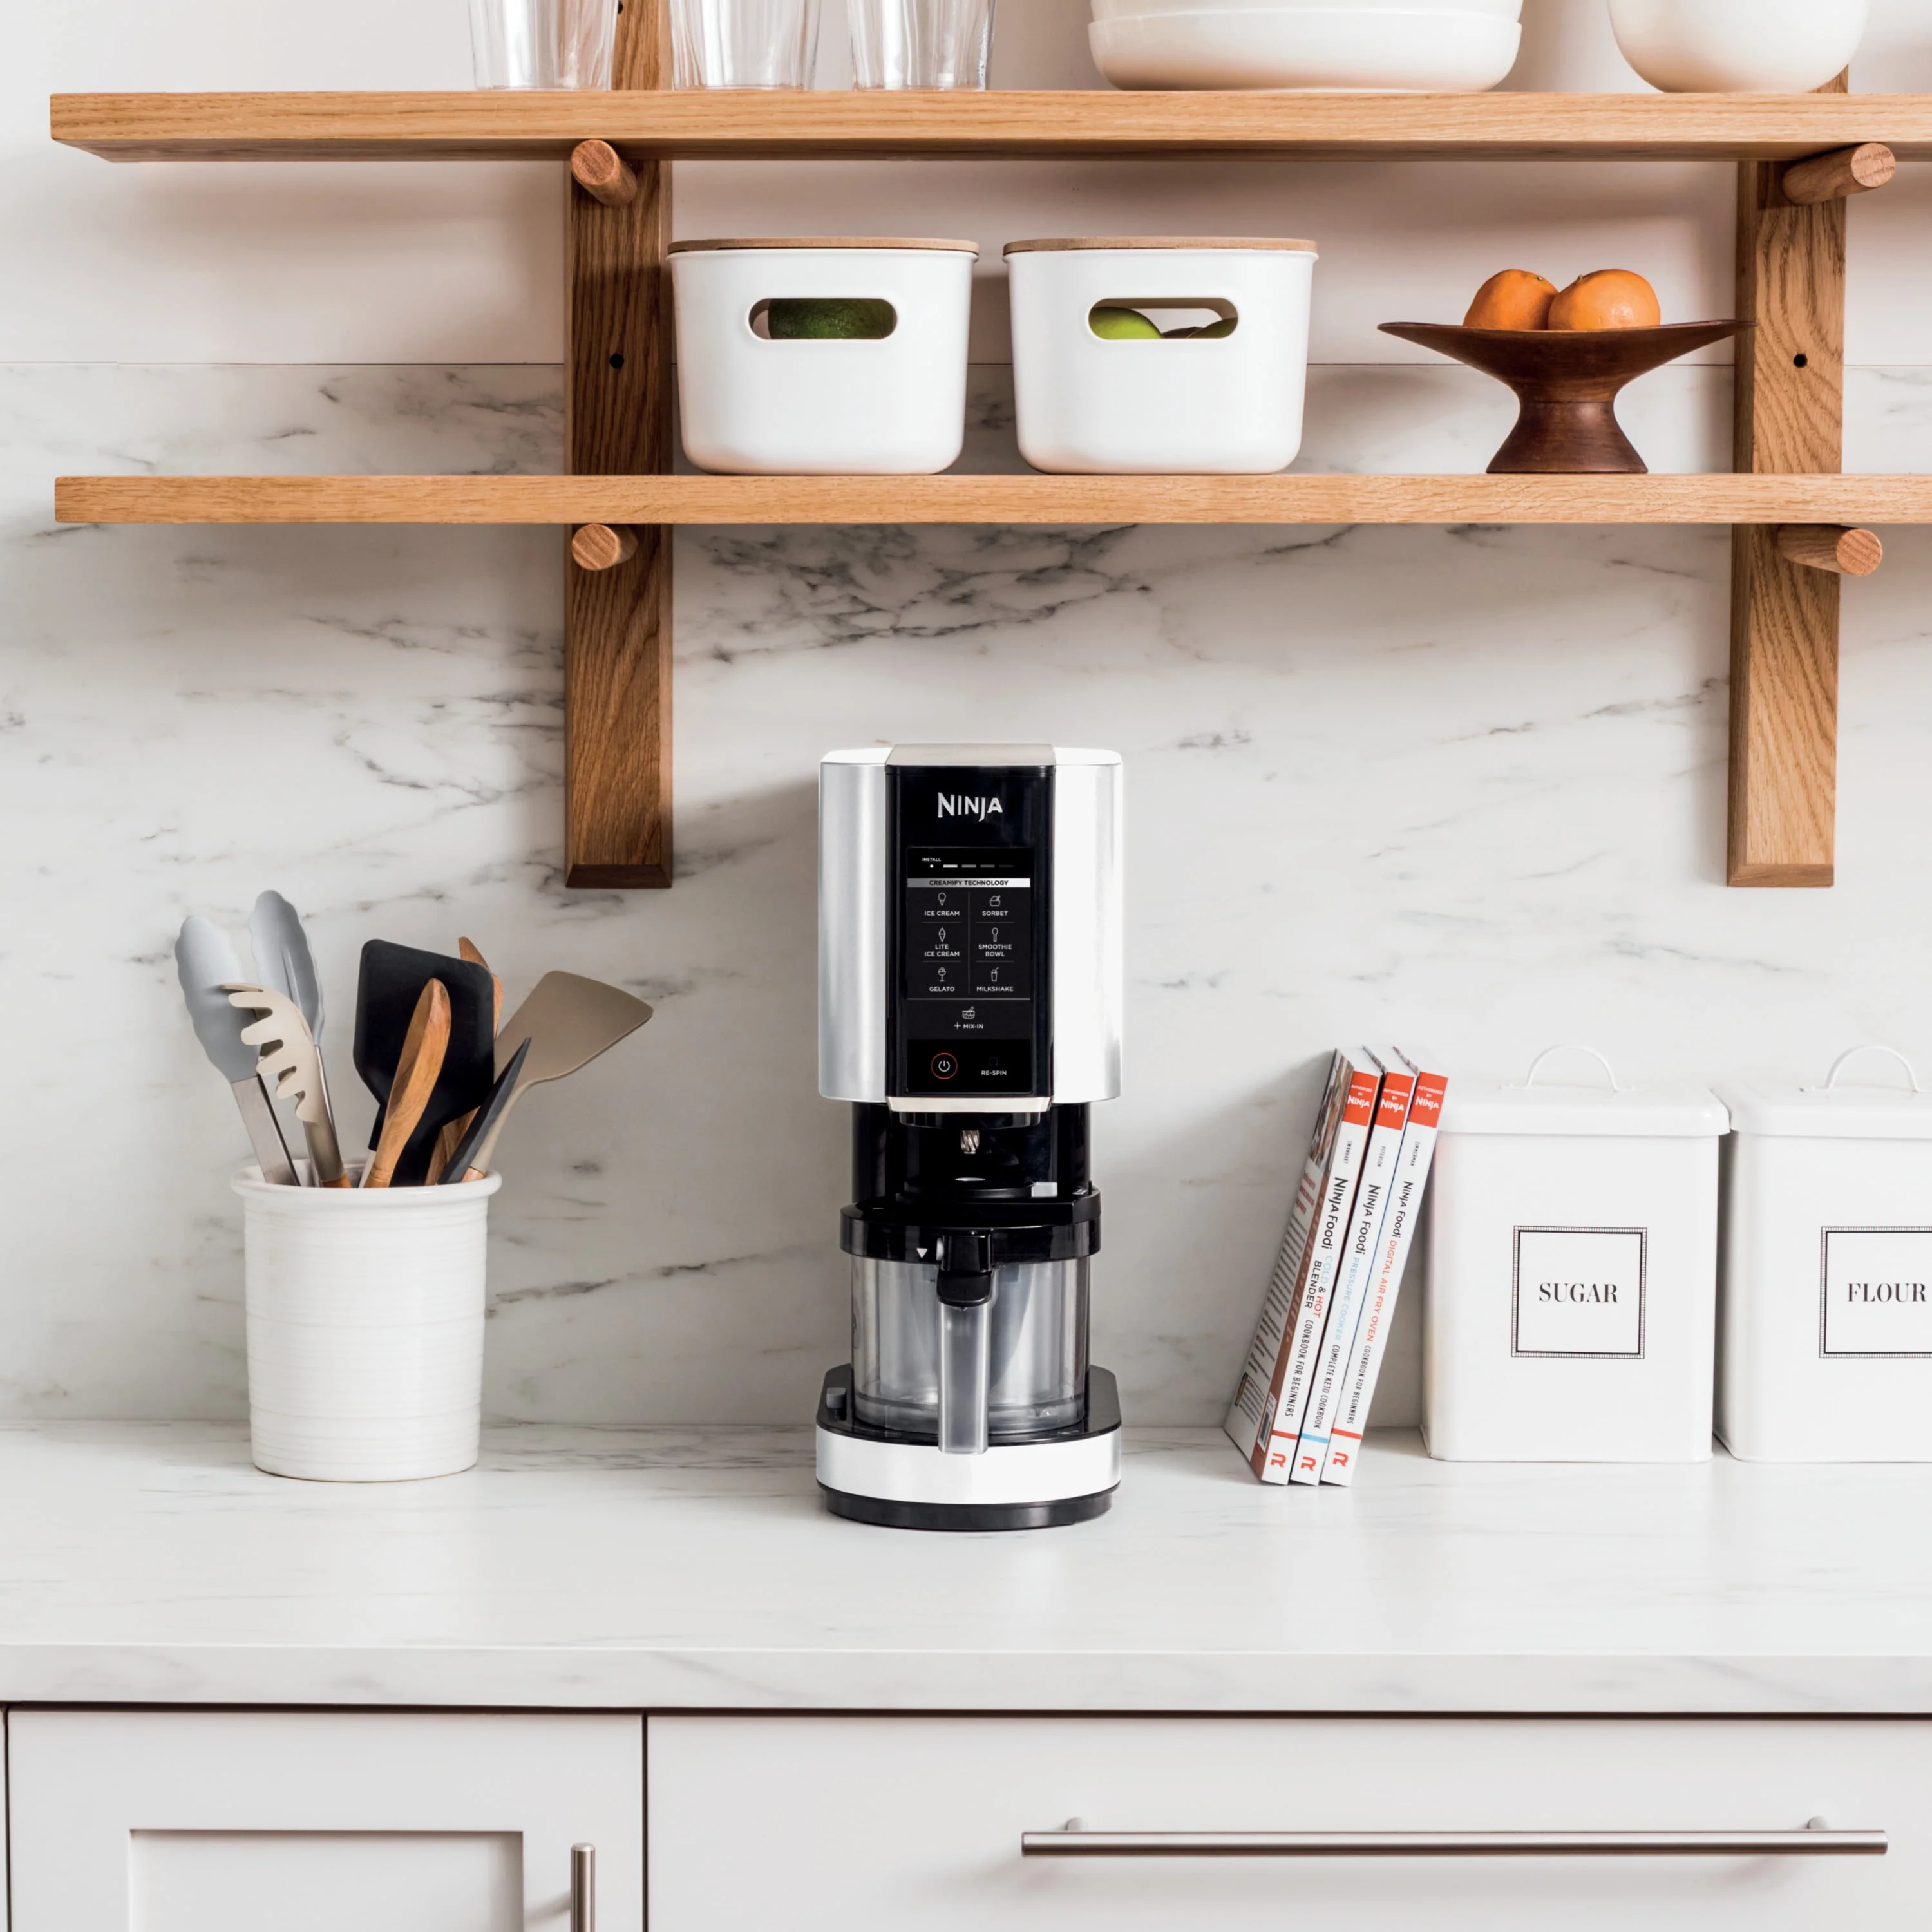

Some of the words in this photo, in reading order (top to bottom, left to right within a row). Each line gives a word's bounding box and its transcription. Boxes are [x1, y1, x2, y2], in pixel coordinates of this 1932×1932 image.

[938, 792, 1003, 822] NINJA
[1347, 1095, 1370, 1108] NINJA
[1383, 1088, 1409, 1097] AUTHORIZED
[1415, 1096, 1439, 1110] NINJA
[1417, 1086, 1443, 1095] AUTHORIZED
[1380, 1099, 1404, 1113] NINJA
[1328, 1177, 1349, 1212] NINJA
[1363, 1184, 1381, 1217] NINJA
[1399, 1181, 1414, 1207] NINJA
[1321, 1215, 1338, 1250] Foodi
[1355, 1221, 1371, 1255] Foodi
[1392, 1211, 1406, 1238] Foodi
[1320, 1255, 1333, 1284] COLD
[1382, 1240, 1397, 1275] DIGITAL
[1305, 1260, 1322, 1309] BLENDER
[1343, 1257, 1359, 1301] PRESSURE
[1378, 1278, 1388, 1294] AIR
[1540, 1283, 1616, 1302] SUGAR
[1849, 1283, 1925, 1302] FLOUR
[1313, 1296, 1324, 1318] HOT
[1374, 1296, 1383, 1314] FRY
[1334, 1303, 1349, 1340] COOKER
[1367, 1316, 1378, 1341] OVEN
[1298, 1320, 1314, 1359] COOKBOOK
[1294, 1361, 1305, 1375] FOR
[1326, 1345, 1340, 1376] COMPLETE
[1358, 1346, 1371, 1377] COOKBOOK
[1285, 1377, 1301, 1417] BEGINNERS
[1322, 1378, 1332, 1393] KETO
[1355, 1379, 1363, 1390] FOR
[1314, 1395, 1328, 1429] COOKBOOK
[1347, 1392, 1360, 1423] BEGINNERS
